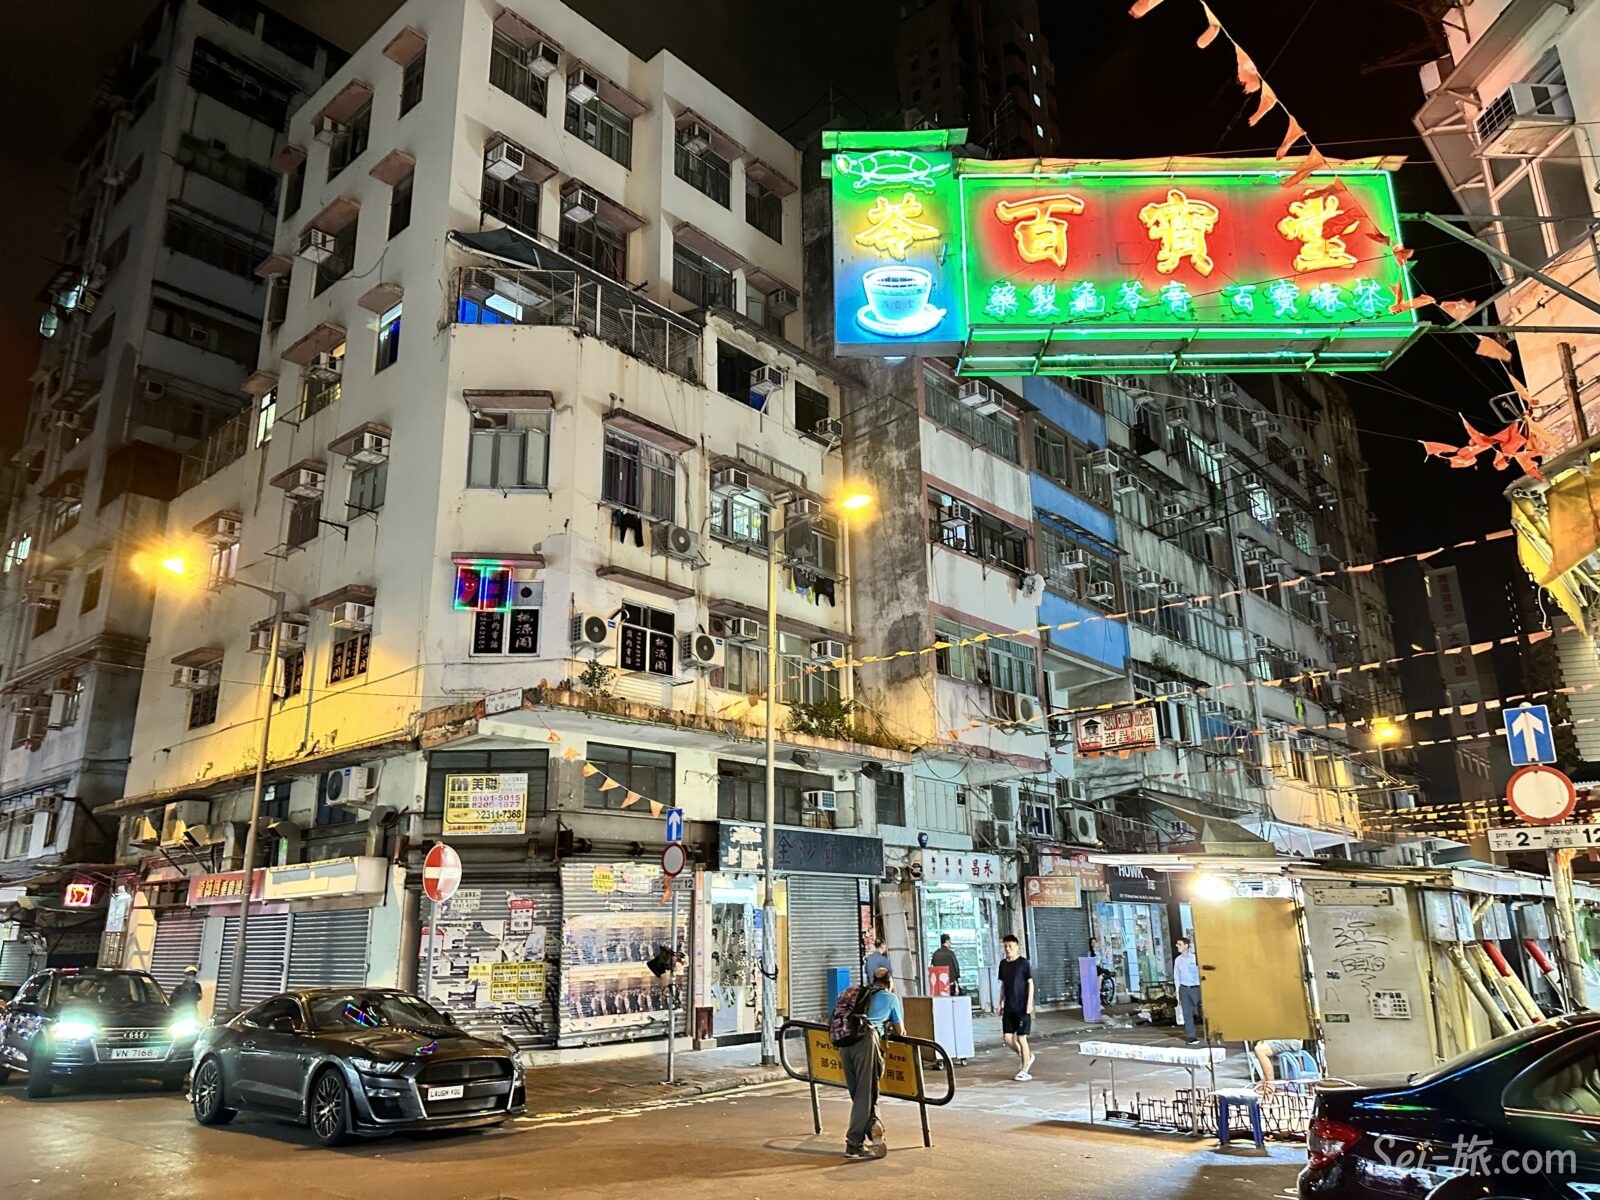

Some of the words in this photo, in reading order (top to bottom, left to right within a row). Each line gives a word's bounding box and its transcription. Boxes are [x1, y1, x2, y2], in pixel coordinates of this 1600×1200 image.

[481, 809, 522, 819] 2311-7368
[1493, 840, 1514, 848] 下午
[684, 880, 694, 888] 12
[888, 1052, 906, 1063] Area
[430, 1089, 449, 1098] LAUGH
